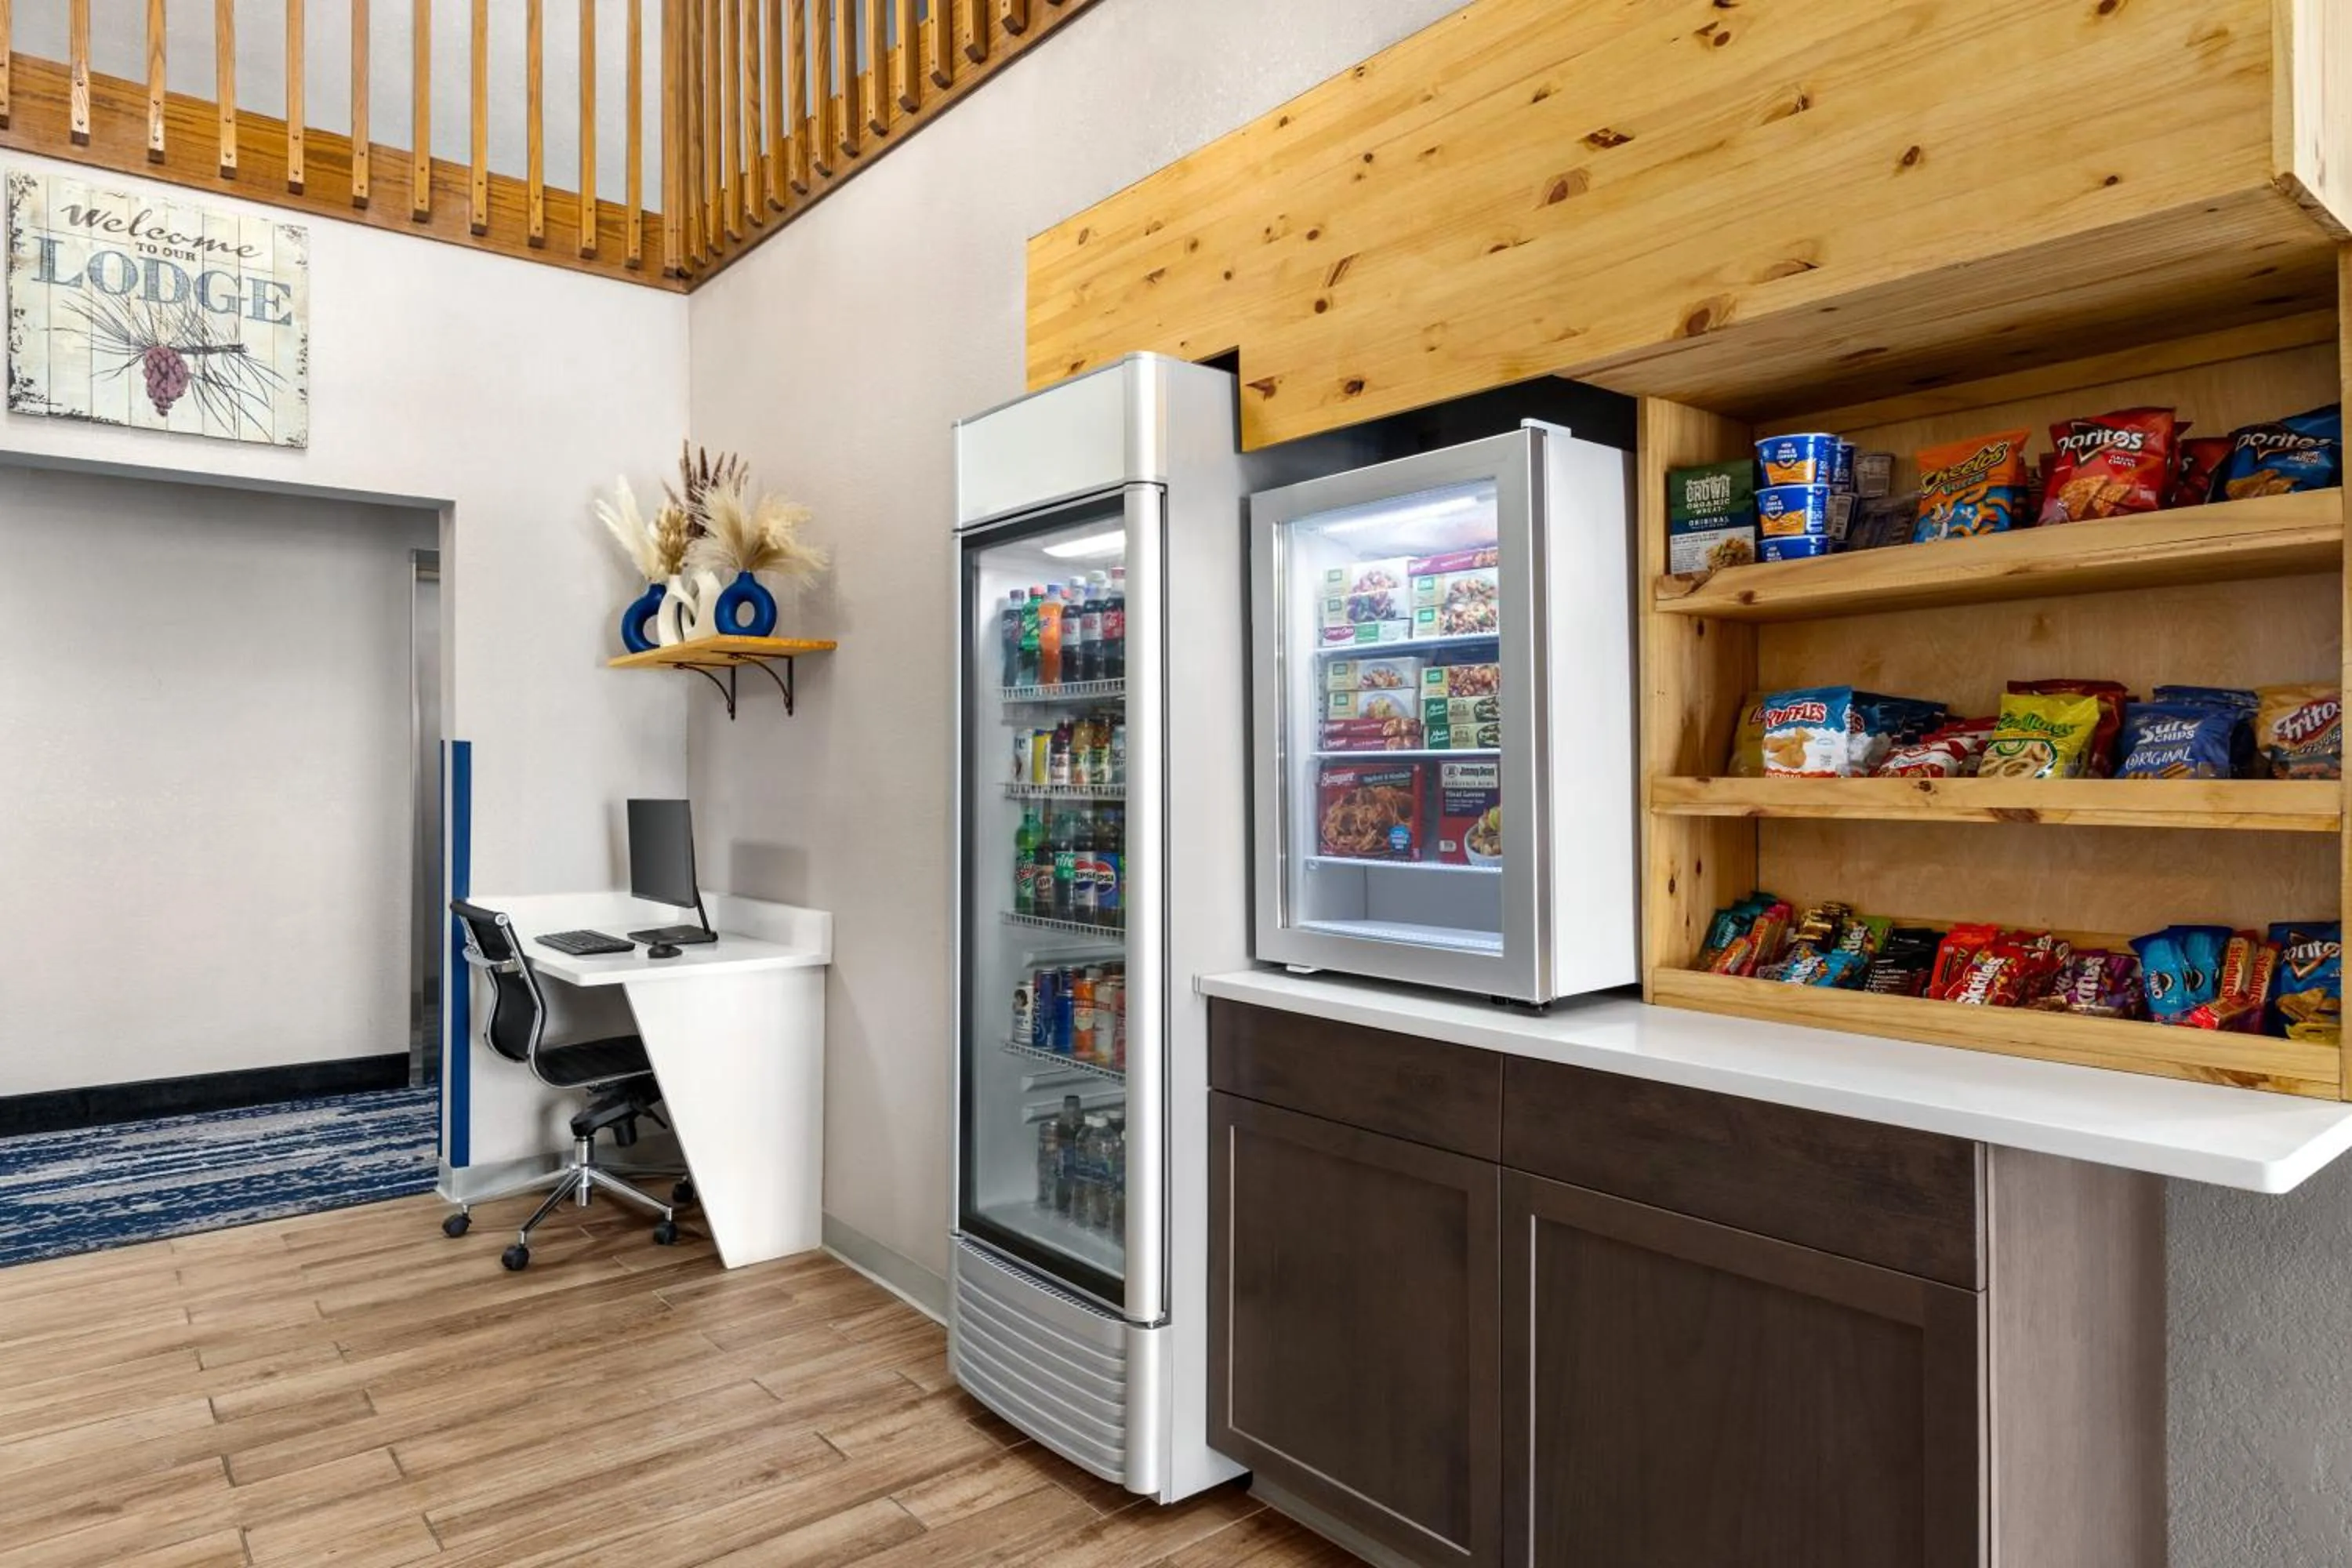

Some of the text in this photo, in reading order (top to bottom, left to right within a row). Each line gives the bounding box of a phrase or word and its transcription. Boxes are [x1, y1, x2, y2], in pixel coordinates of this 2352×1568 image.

[60, 202, 265, 260] Welcome
[136, 241, 197, 262] TO OUR
[31, 235, 293, 327] LODGE
[2056, 428, 2145, 458] Doritos
[2235, 432, 2333, 452] Doritos
[1921, 441, 2009, 499] Cheetos
[1686, 498, 1730, 510] ORGANIC
[1764, 702, 1827, 729] RUFFLES
[2271, 702, 2341, 740] Frito
[2154, 729, 2196, 743] CHIPS
[2125, 745, 2194, 771] ORIGINAL
[2282, 940, 2340, 964] Dorito
